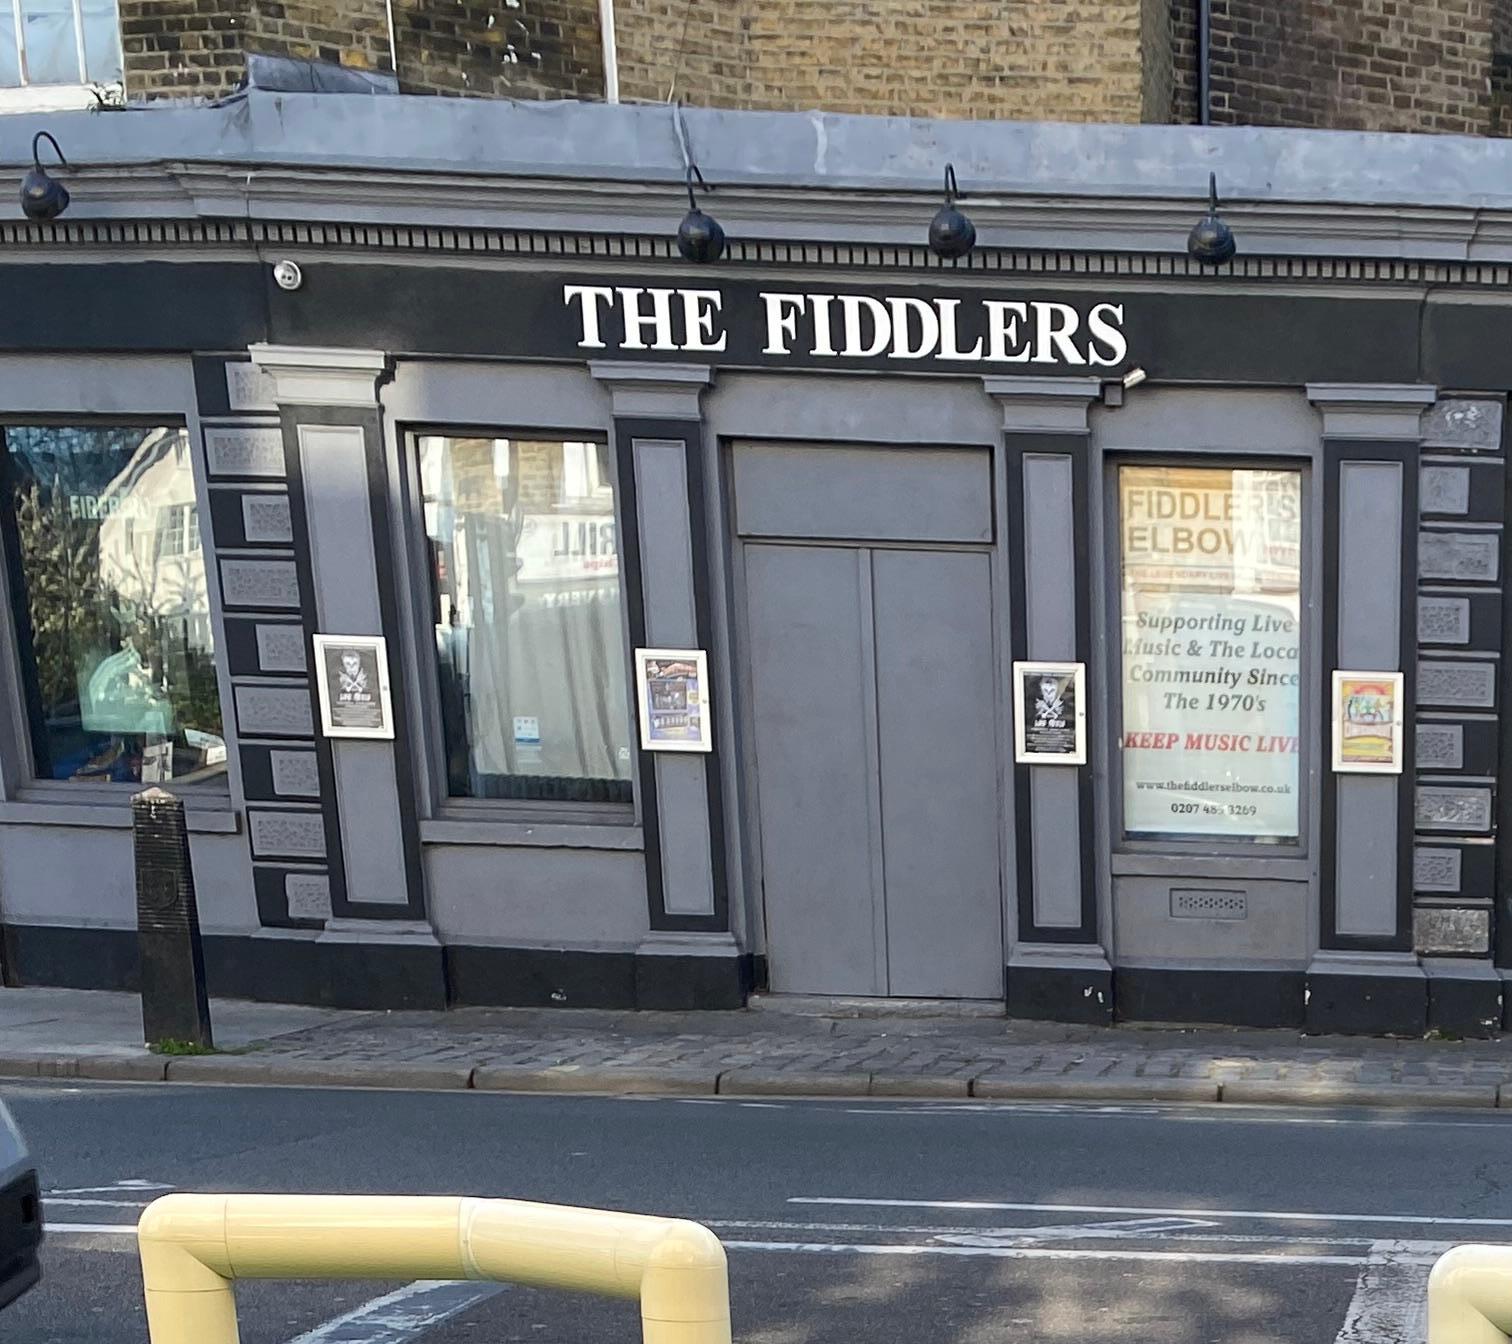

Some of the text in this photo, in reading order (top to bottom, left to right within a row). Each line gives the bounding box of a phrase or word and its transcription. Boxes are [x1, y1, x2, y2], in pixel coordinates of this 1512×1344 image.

[563, 284, 1128, 367] THE FIDDLERS
[1128, 527, 1262, 556] ELBOW
[1136, 611, 1293, 636] Supporting Live
[1123, 638, 1299, 660] Music & The Loca
[1130, 664, 1299, 689] Community Since
[1163, 692, 1267, 712] The 1970's
[1125, 732, 1180, 750] KEEP
[1185, 734, 1252, 751] MUSIC
[1171, 803, 1199, 814] 0207
